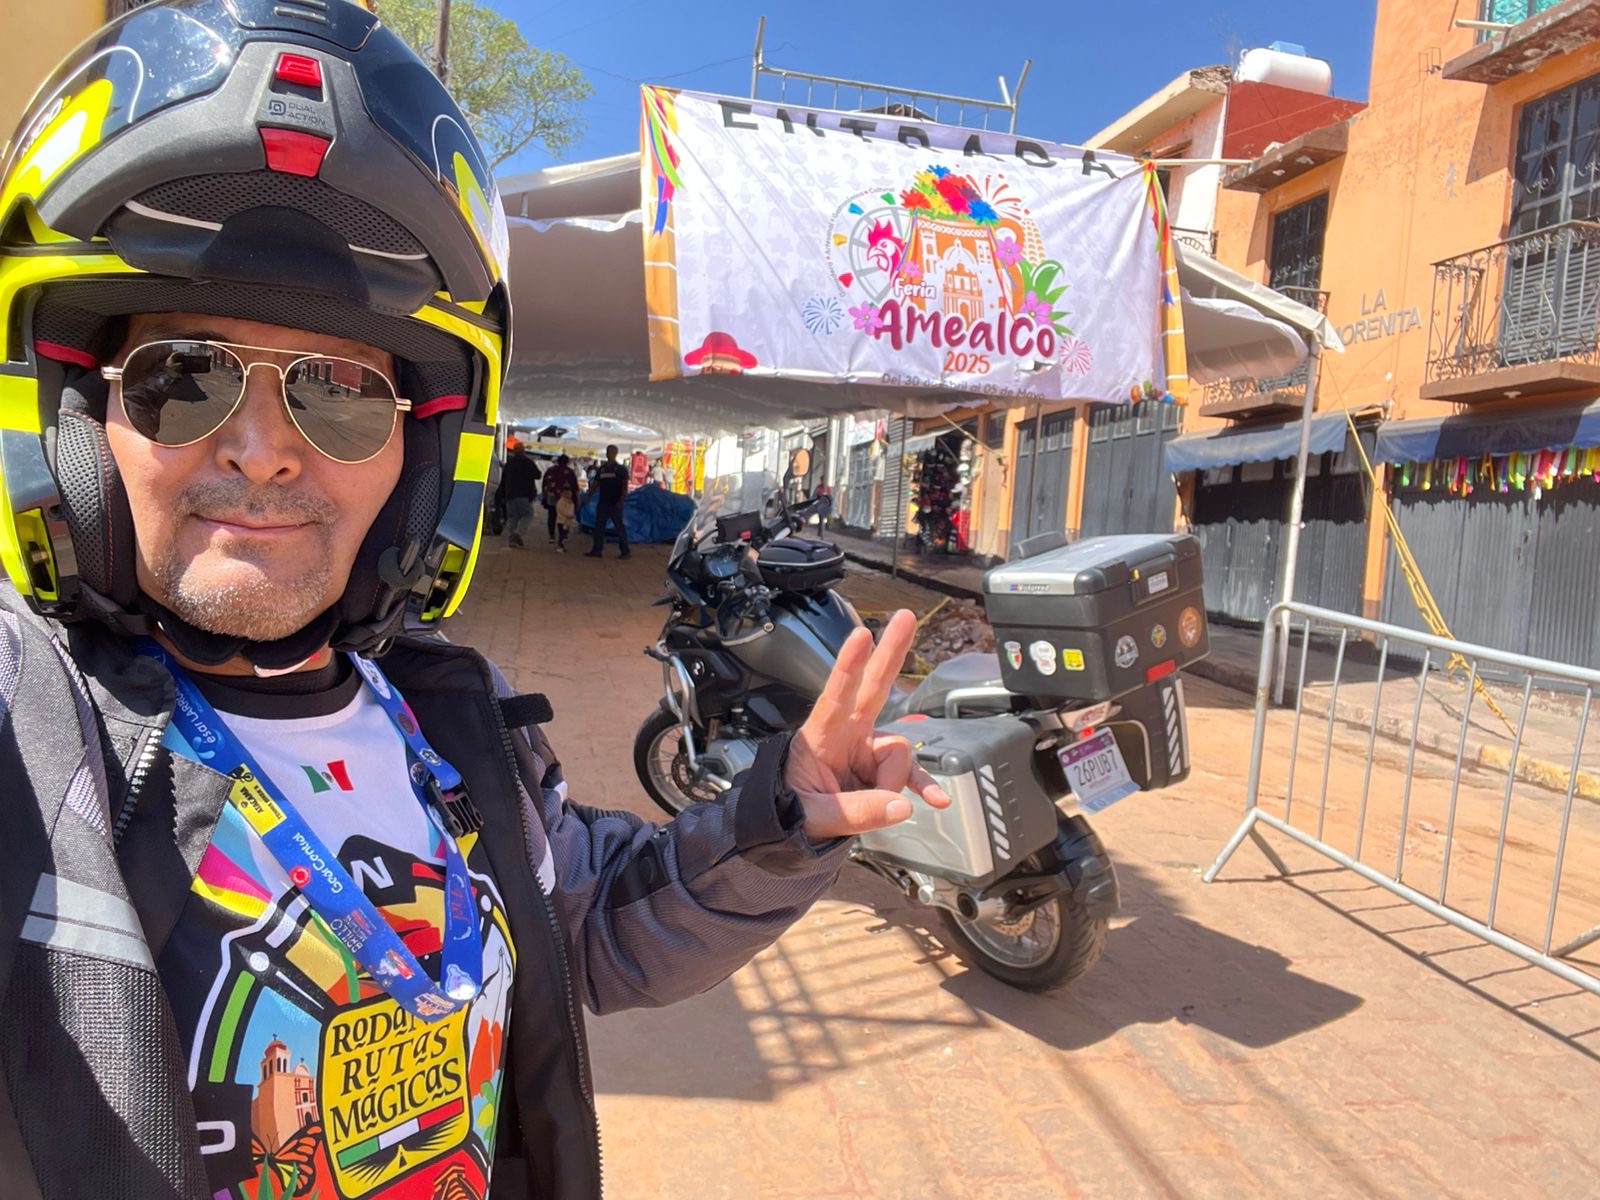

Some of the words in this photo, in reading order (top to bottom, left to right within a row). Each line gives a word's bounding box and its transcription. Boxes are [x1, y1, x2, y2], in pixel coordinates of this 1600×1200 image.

[288, 102, 316, 115] DUAL
[288, 112, 326, 126] ACTION
[894, 278, 936, 298] Feria
[1361, 288, 1386, 316] LA
[1336, 306, 1421, 346] ORENITA
[944, 352, 991, 374] 2025
[881, 373, 901, 385] Del
[905, 375, 920, 386] 30
[240, 786, 264, 814] ATACAMA
[330, 919, 363, 953] BRILLO
